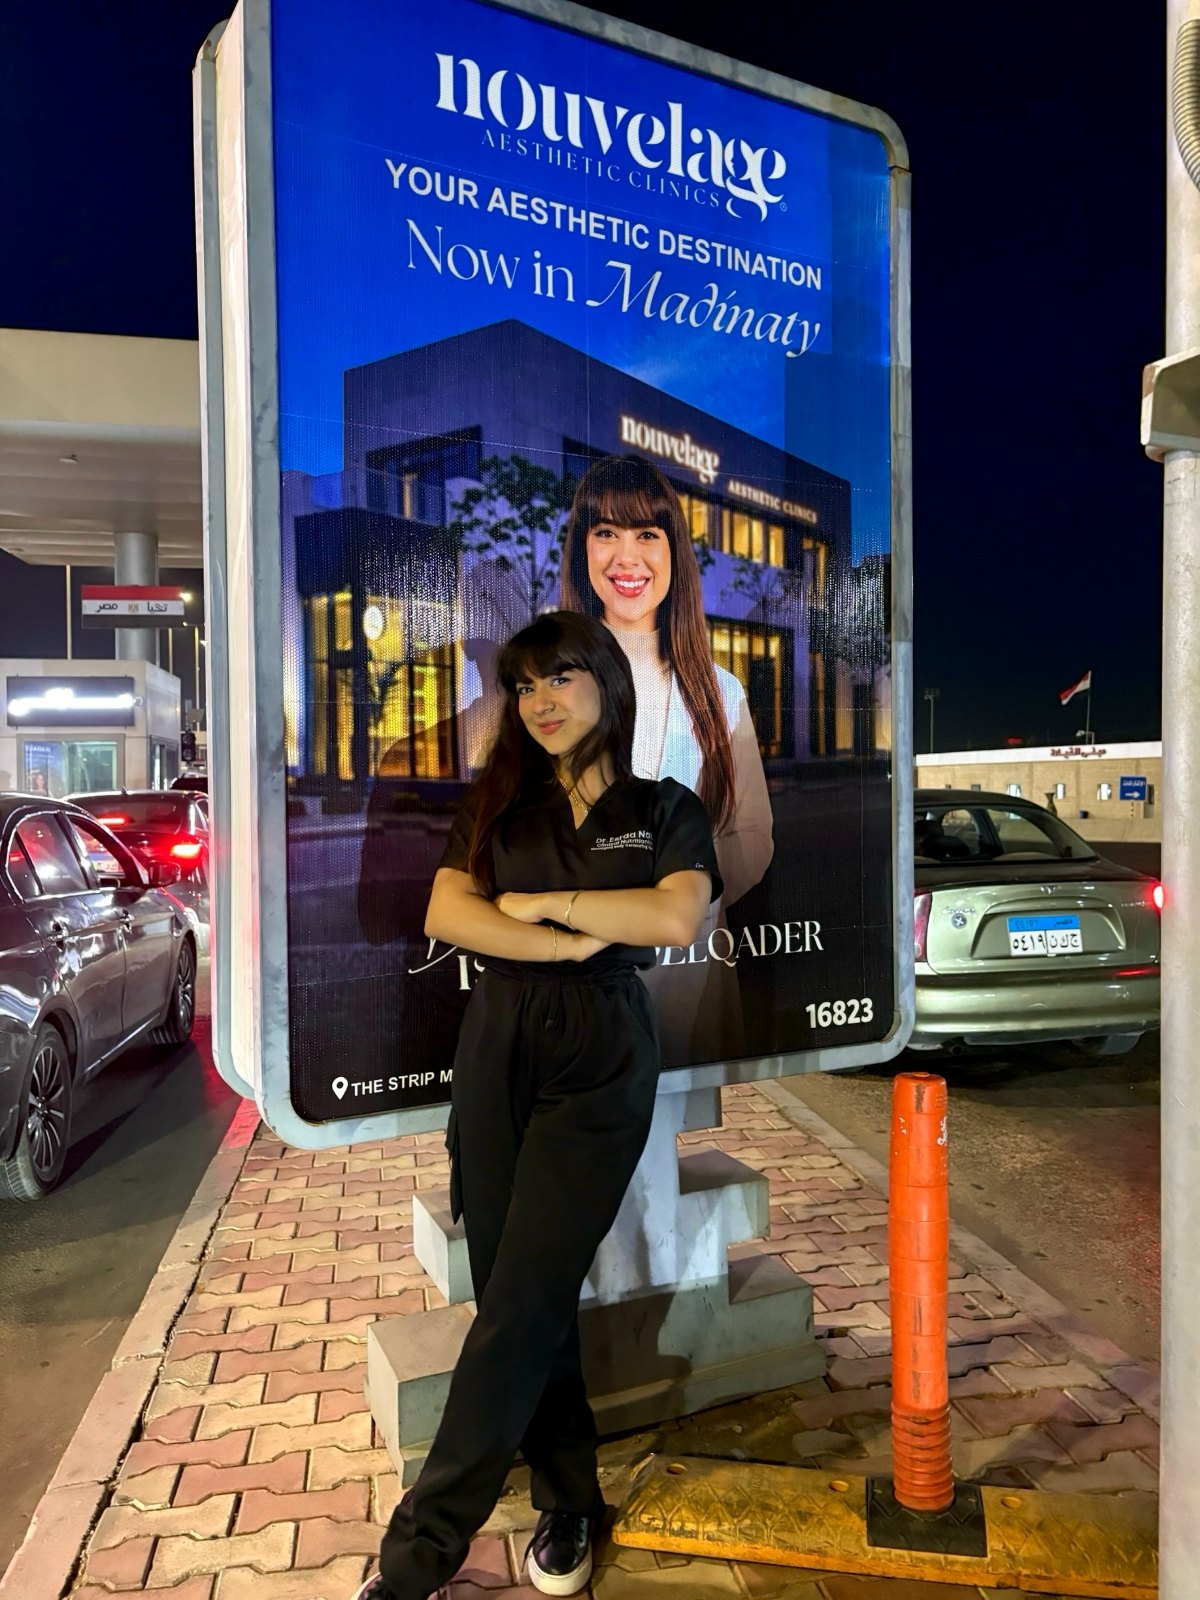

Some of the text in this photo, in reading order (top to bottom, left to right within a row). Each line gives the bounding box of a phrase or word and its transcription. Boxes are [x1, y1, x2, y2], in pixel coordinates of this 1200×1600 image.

[434, 52, 787, 222] nouvelage
[481, 129, 719, 208] AESTHETIC CLINICS
[385, 158, 822, 290] YOUR AESTHETIC DESTINATION
[406, 219, 821, 358] Now in Madinaty
[728, 479, 818, 524] AESTHETIC CLINICS
[96, 602, 168, 615] تحيا مصر
[655, 920, 824, 967] ELQADER
[1013, 934, 1046, 951] ٥٤١٩
[806, 997, 873, 1029] 16823
[351, 1069, 453, 1097] THE STRIP M
